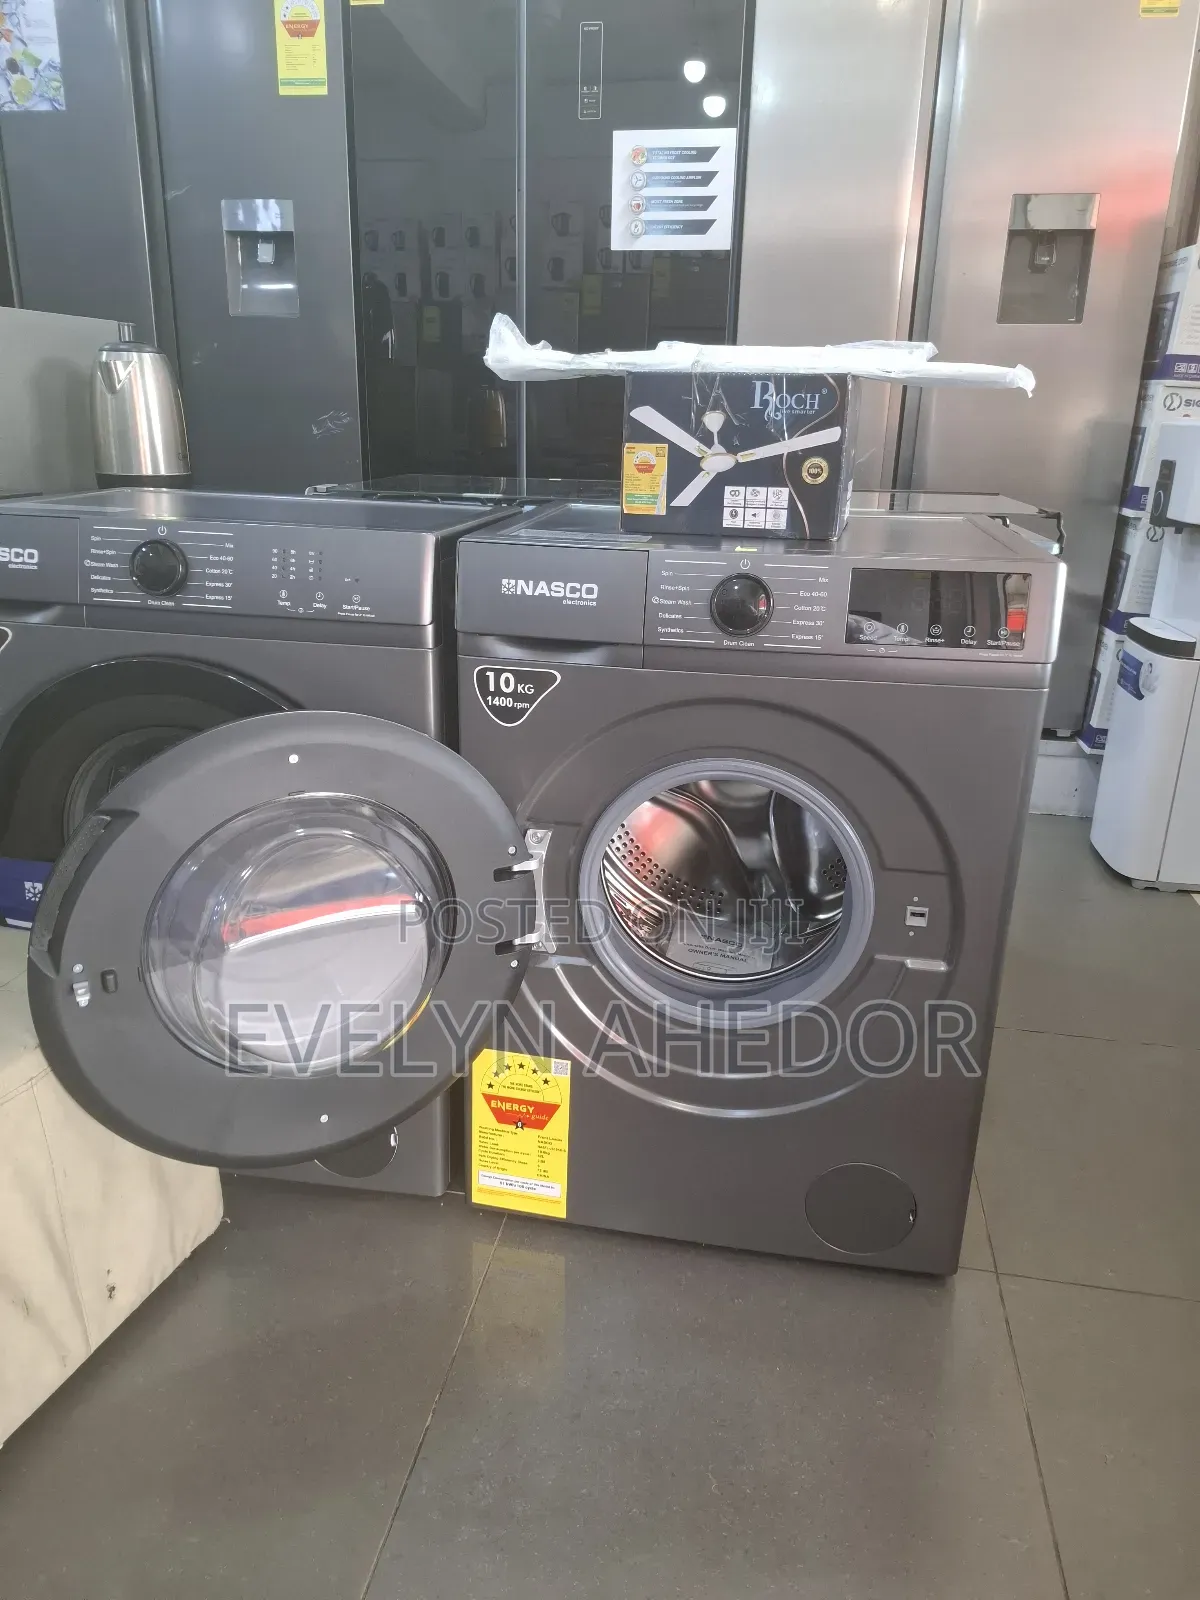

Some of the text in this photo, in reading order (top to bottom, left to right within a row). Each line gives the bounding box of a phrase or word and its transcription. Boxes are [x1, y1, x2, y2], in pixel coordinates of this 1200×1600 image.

[750, 380, 820, 421] ROCH
[661, 570, 673, 578] Spin
[516, 580, 598, 599] NASCO
[660, 584, 690, 592] Rinse+Spin
[658, 612, 682, 620] Delicates
[792, 633, 814, 641] Express
[859, 634, 878, 642] Speed
[960, 638, 978, 646] Delay
[987, 639, 1020, 647] Start/Pause
[486, 672, 535, 694] 10 KG
[486, 696, 530, 709] 1400 rpm
[688, 948, 719, 957] OWNER'S
[490, 1100, 535, 1114] ENERGY
